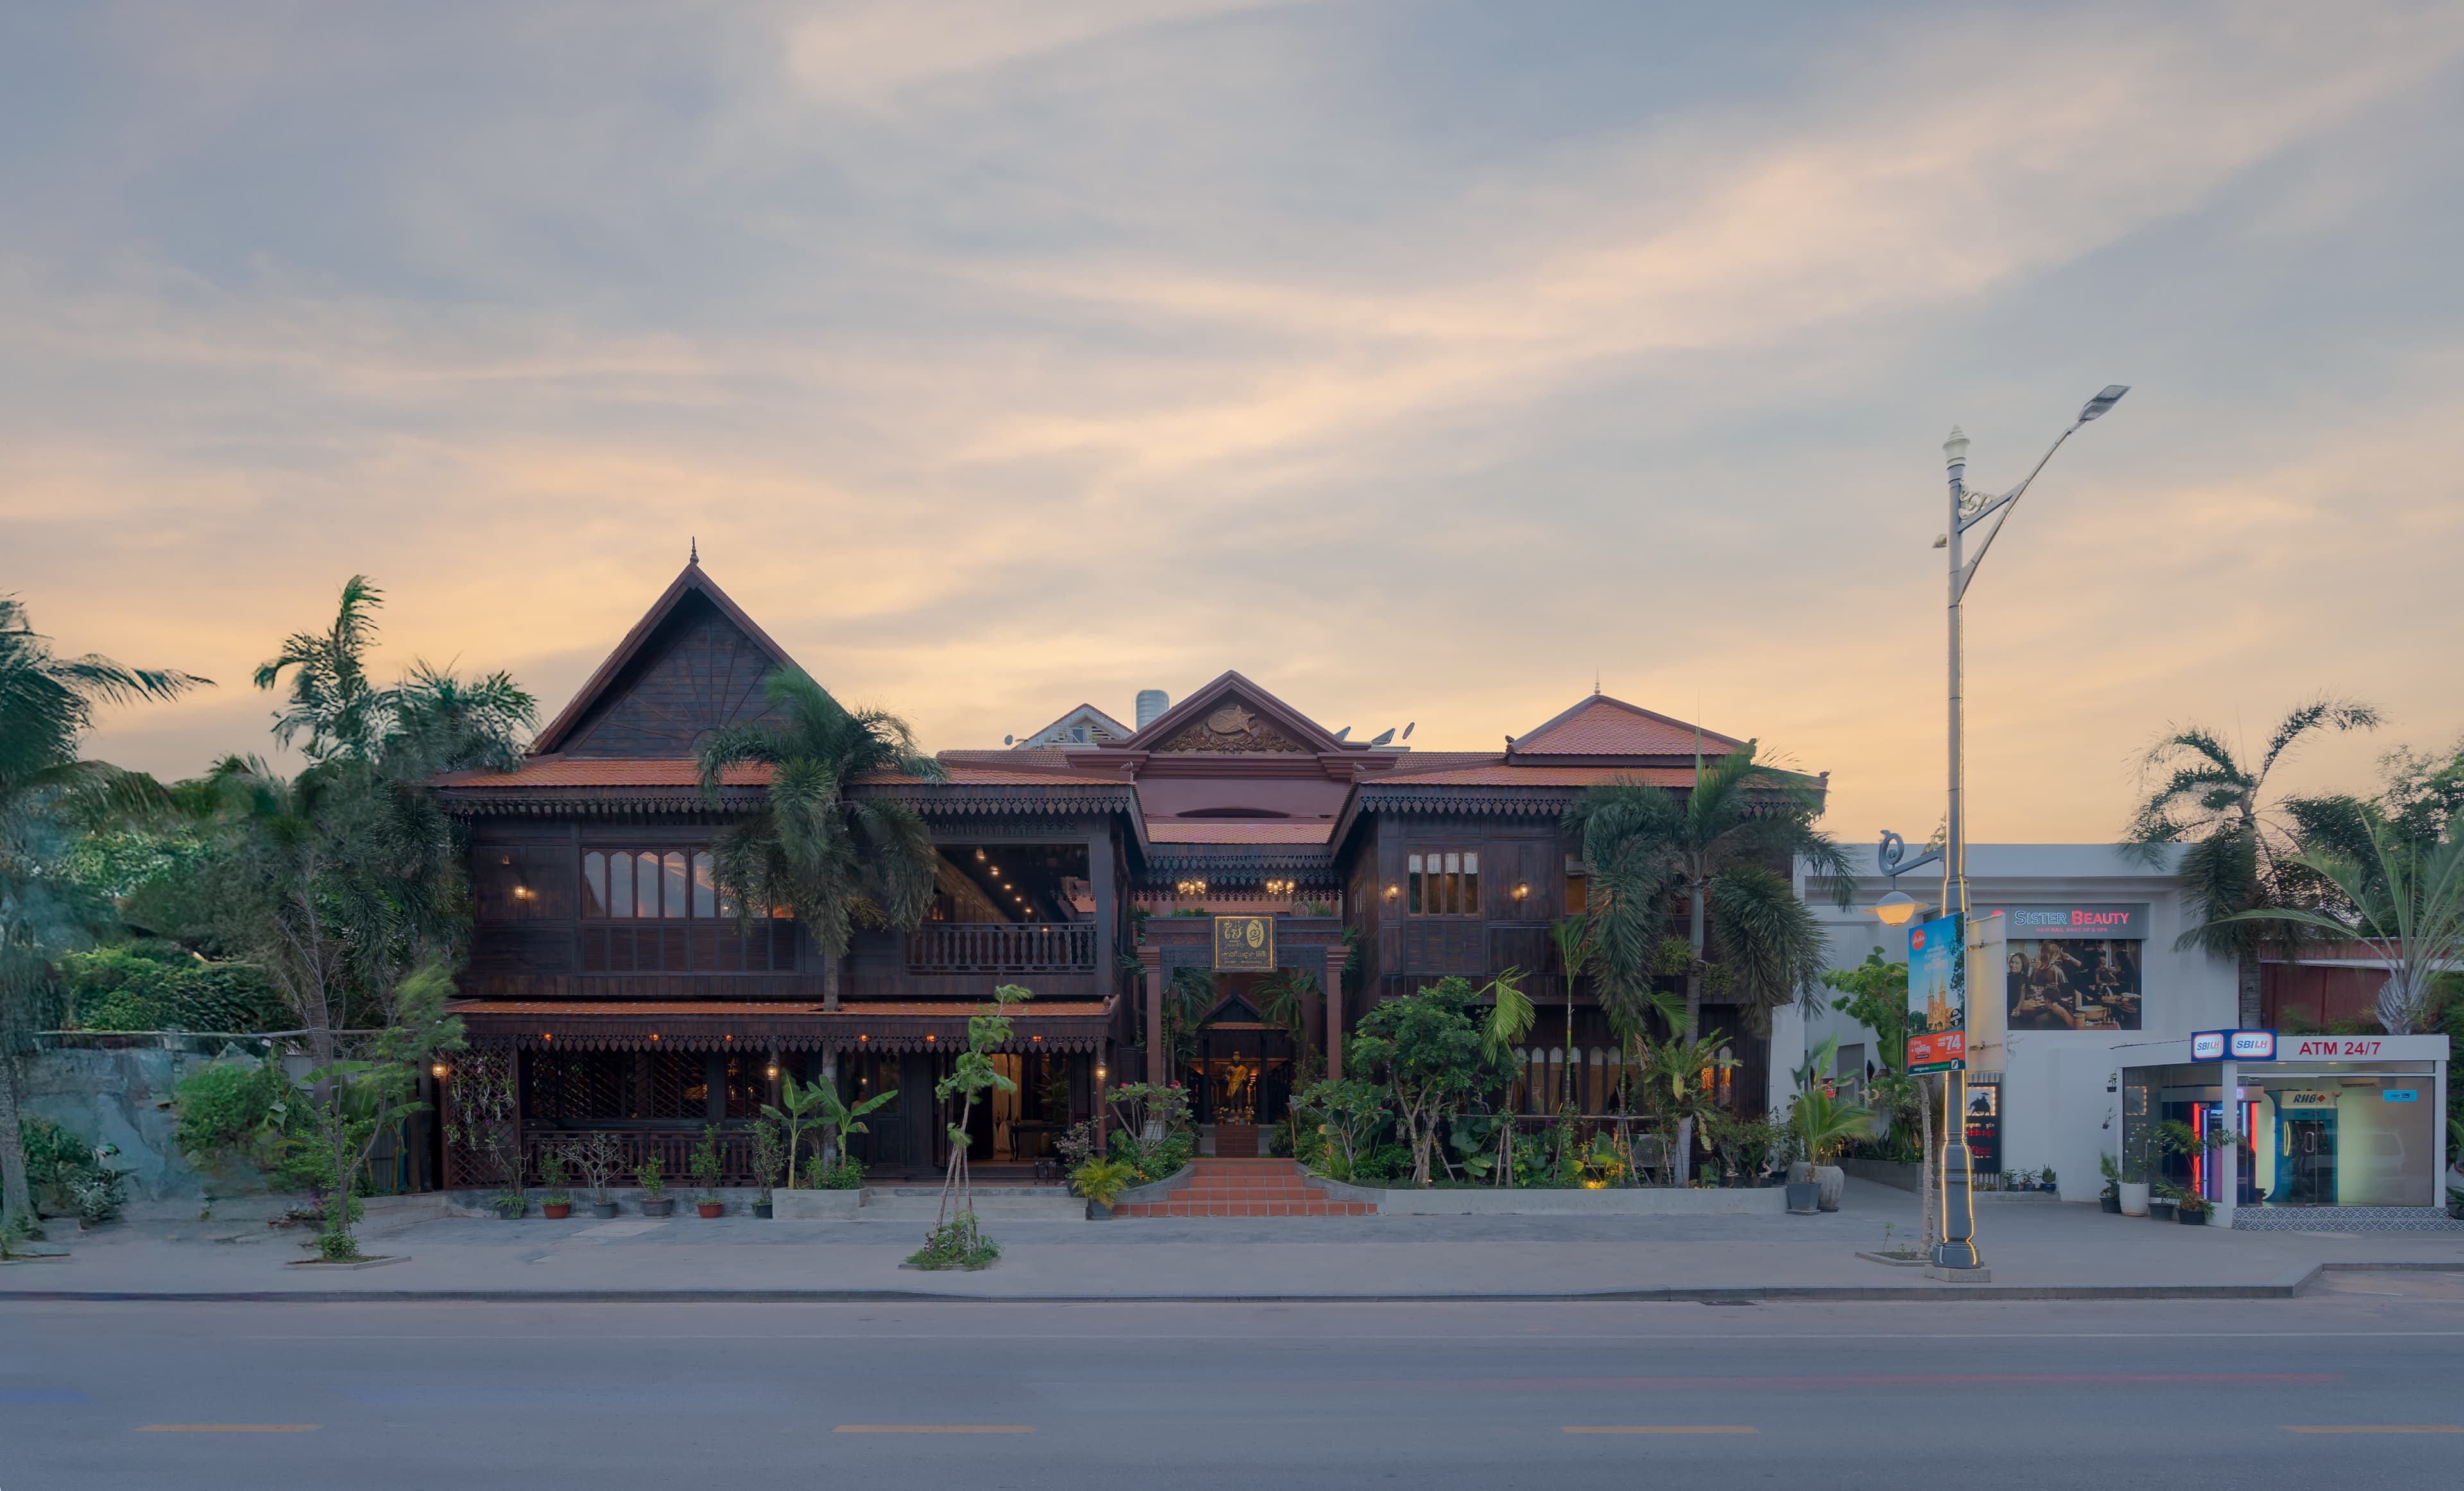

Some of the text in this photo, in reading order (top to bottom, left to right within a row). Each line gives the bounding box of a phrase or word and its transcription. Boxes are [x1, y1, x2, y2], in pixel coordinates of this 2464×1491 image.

[2014, 910, 2130, 925] SISTER BEAUTY
[1946, 1034, 1961, 1051] 74
[2299, 1042, 2381, 1055] ATM 24/7
[2293, 1094, 2317, 1103] RHB
